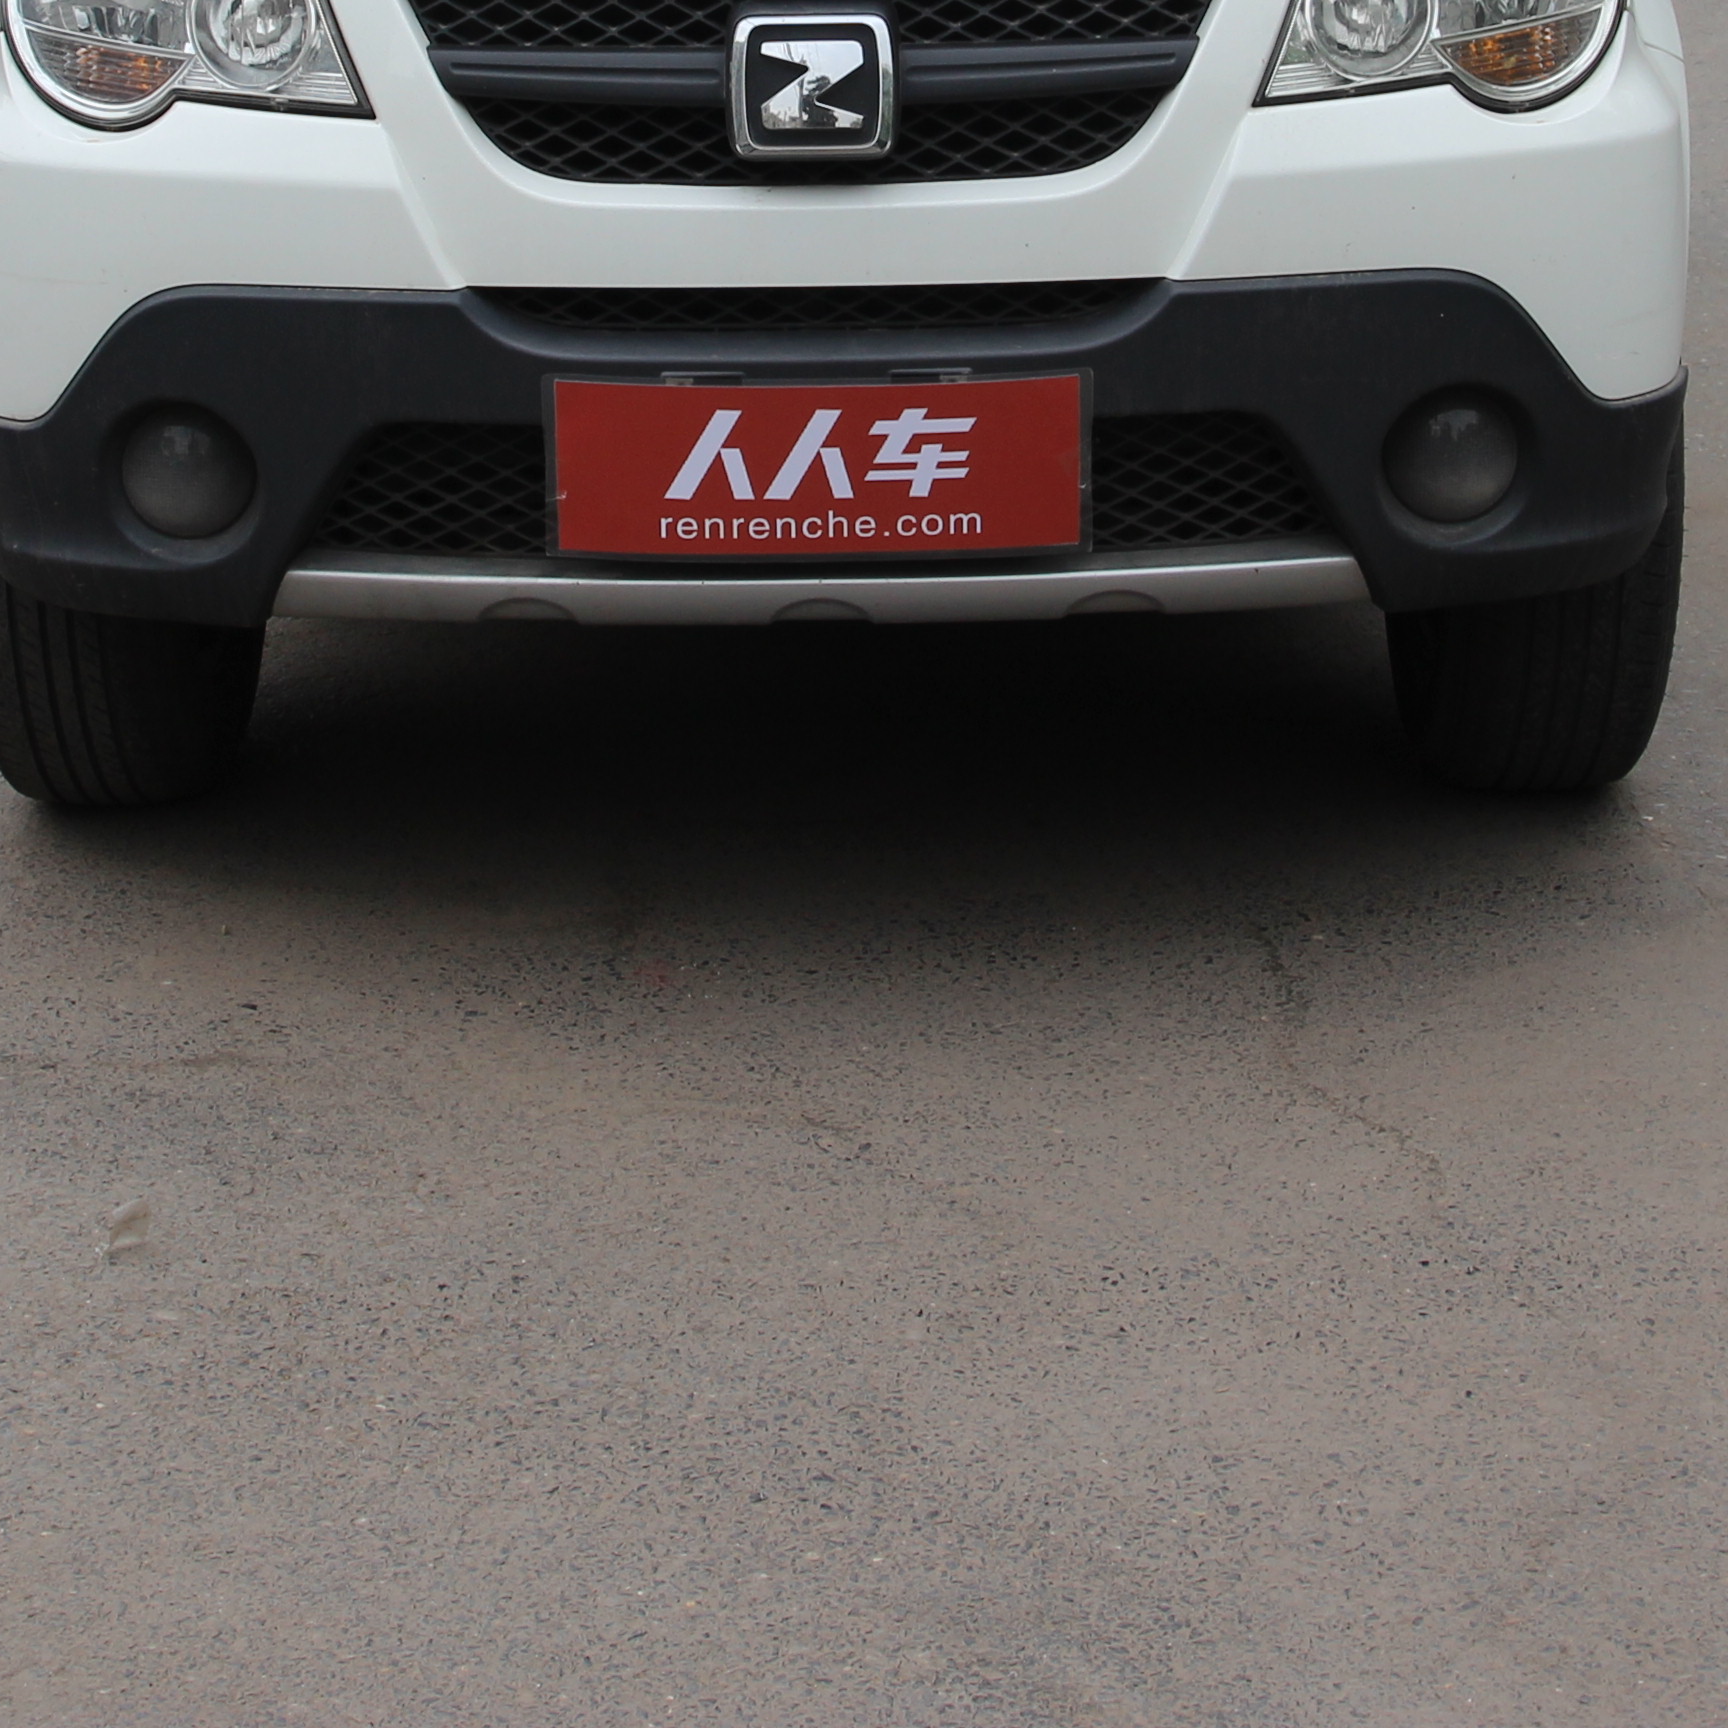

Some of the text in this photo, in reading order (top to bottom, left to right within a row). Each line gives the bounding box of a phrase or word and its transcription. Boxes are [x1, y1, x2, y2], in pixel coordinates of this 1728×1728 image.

[663, 407, 977, 500] 人人车
[659, 509, 983, 540] renrenche.com
